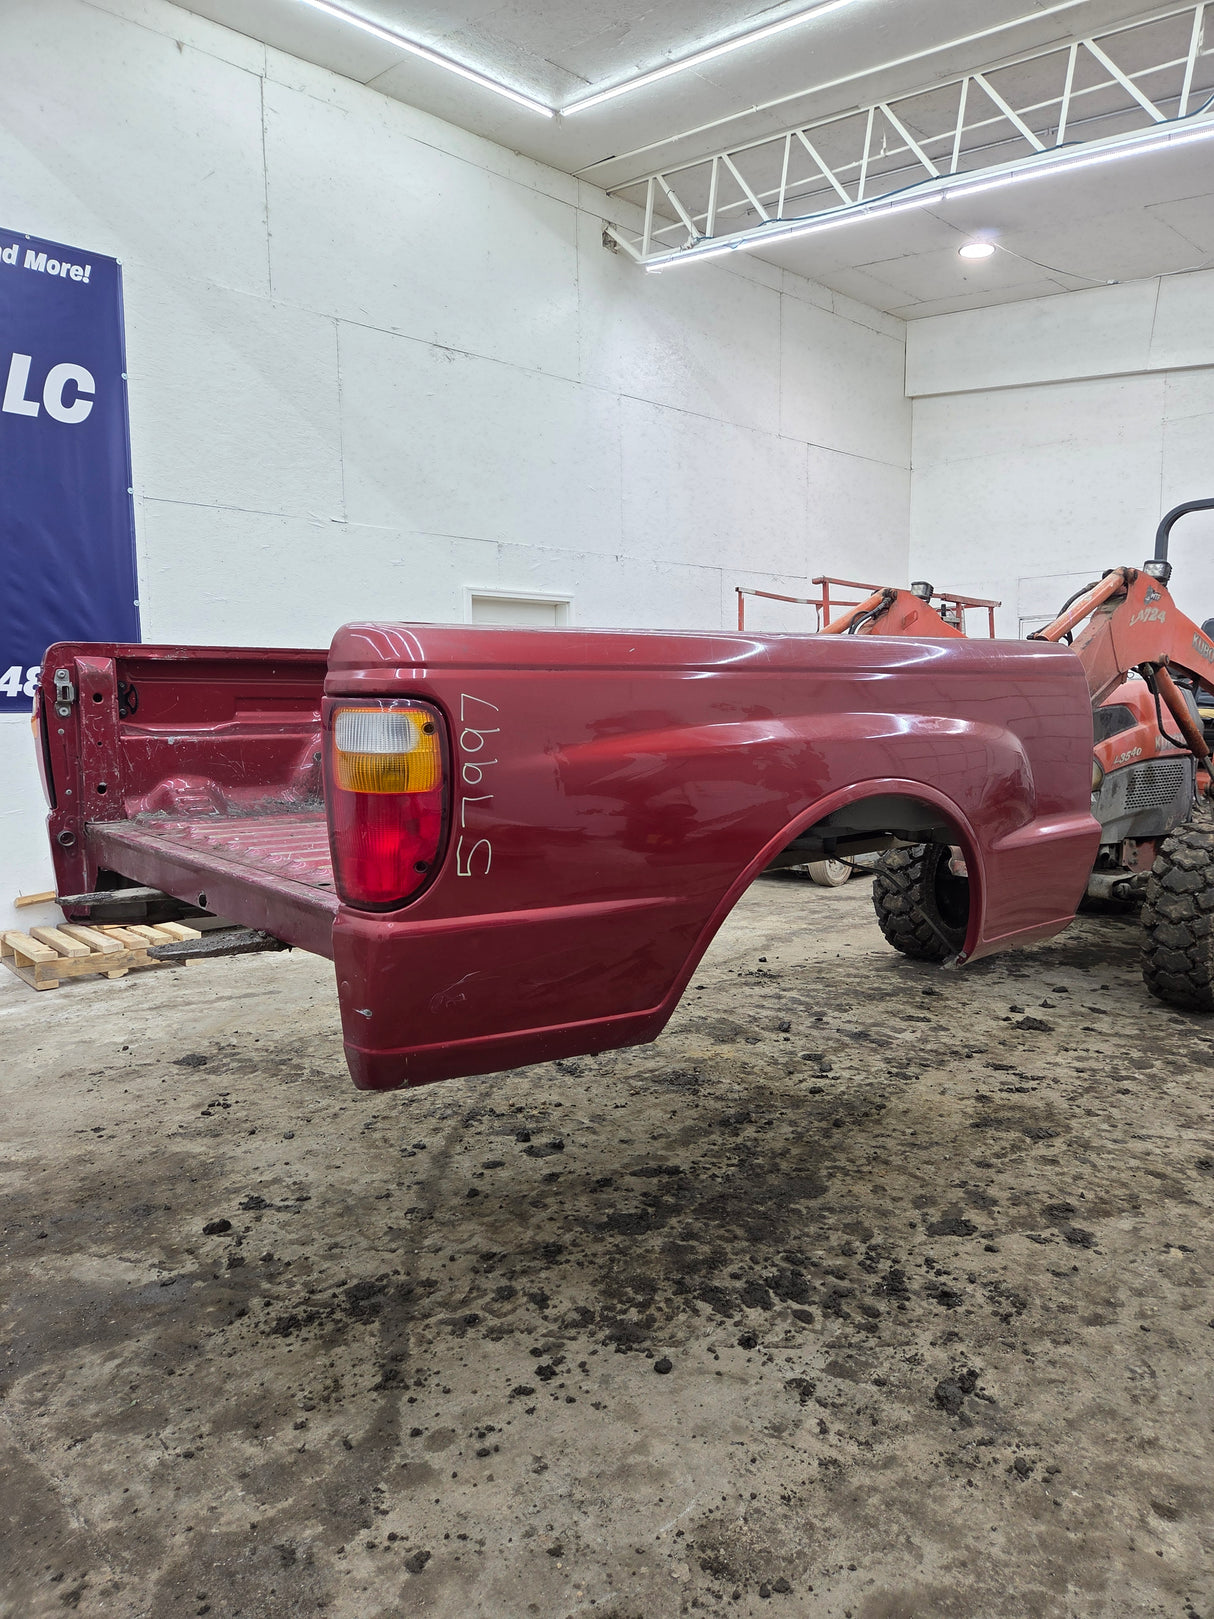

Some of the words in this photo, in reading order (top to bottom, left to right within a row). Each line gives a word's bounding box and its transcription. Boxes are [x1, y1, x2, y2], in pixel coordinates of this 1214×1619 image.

[0, 244, 19, 265] d
[24, 249, 92, 284] More!
[2, 352, 96, 424] LC
[1129, 607, 1166, 627] LA724
[1113, 746, 1143, 764] L3540
[457, 693, 500, 876] 57997
